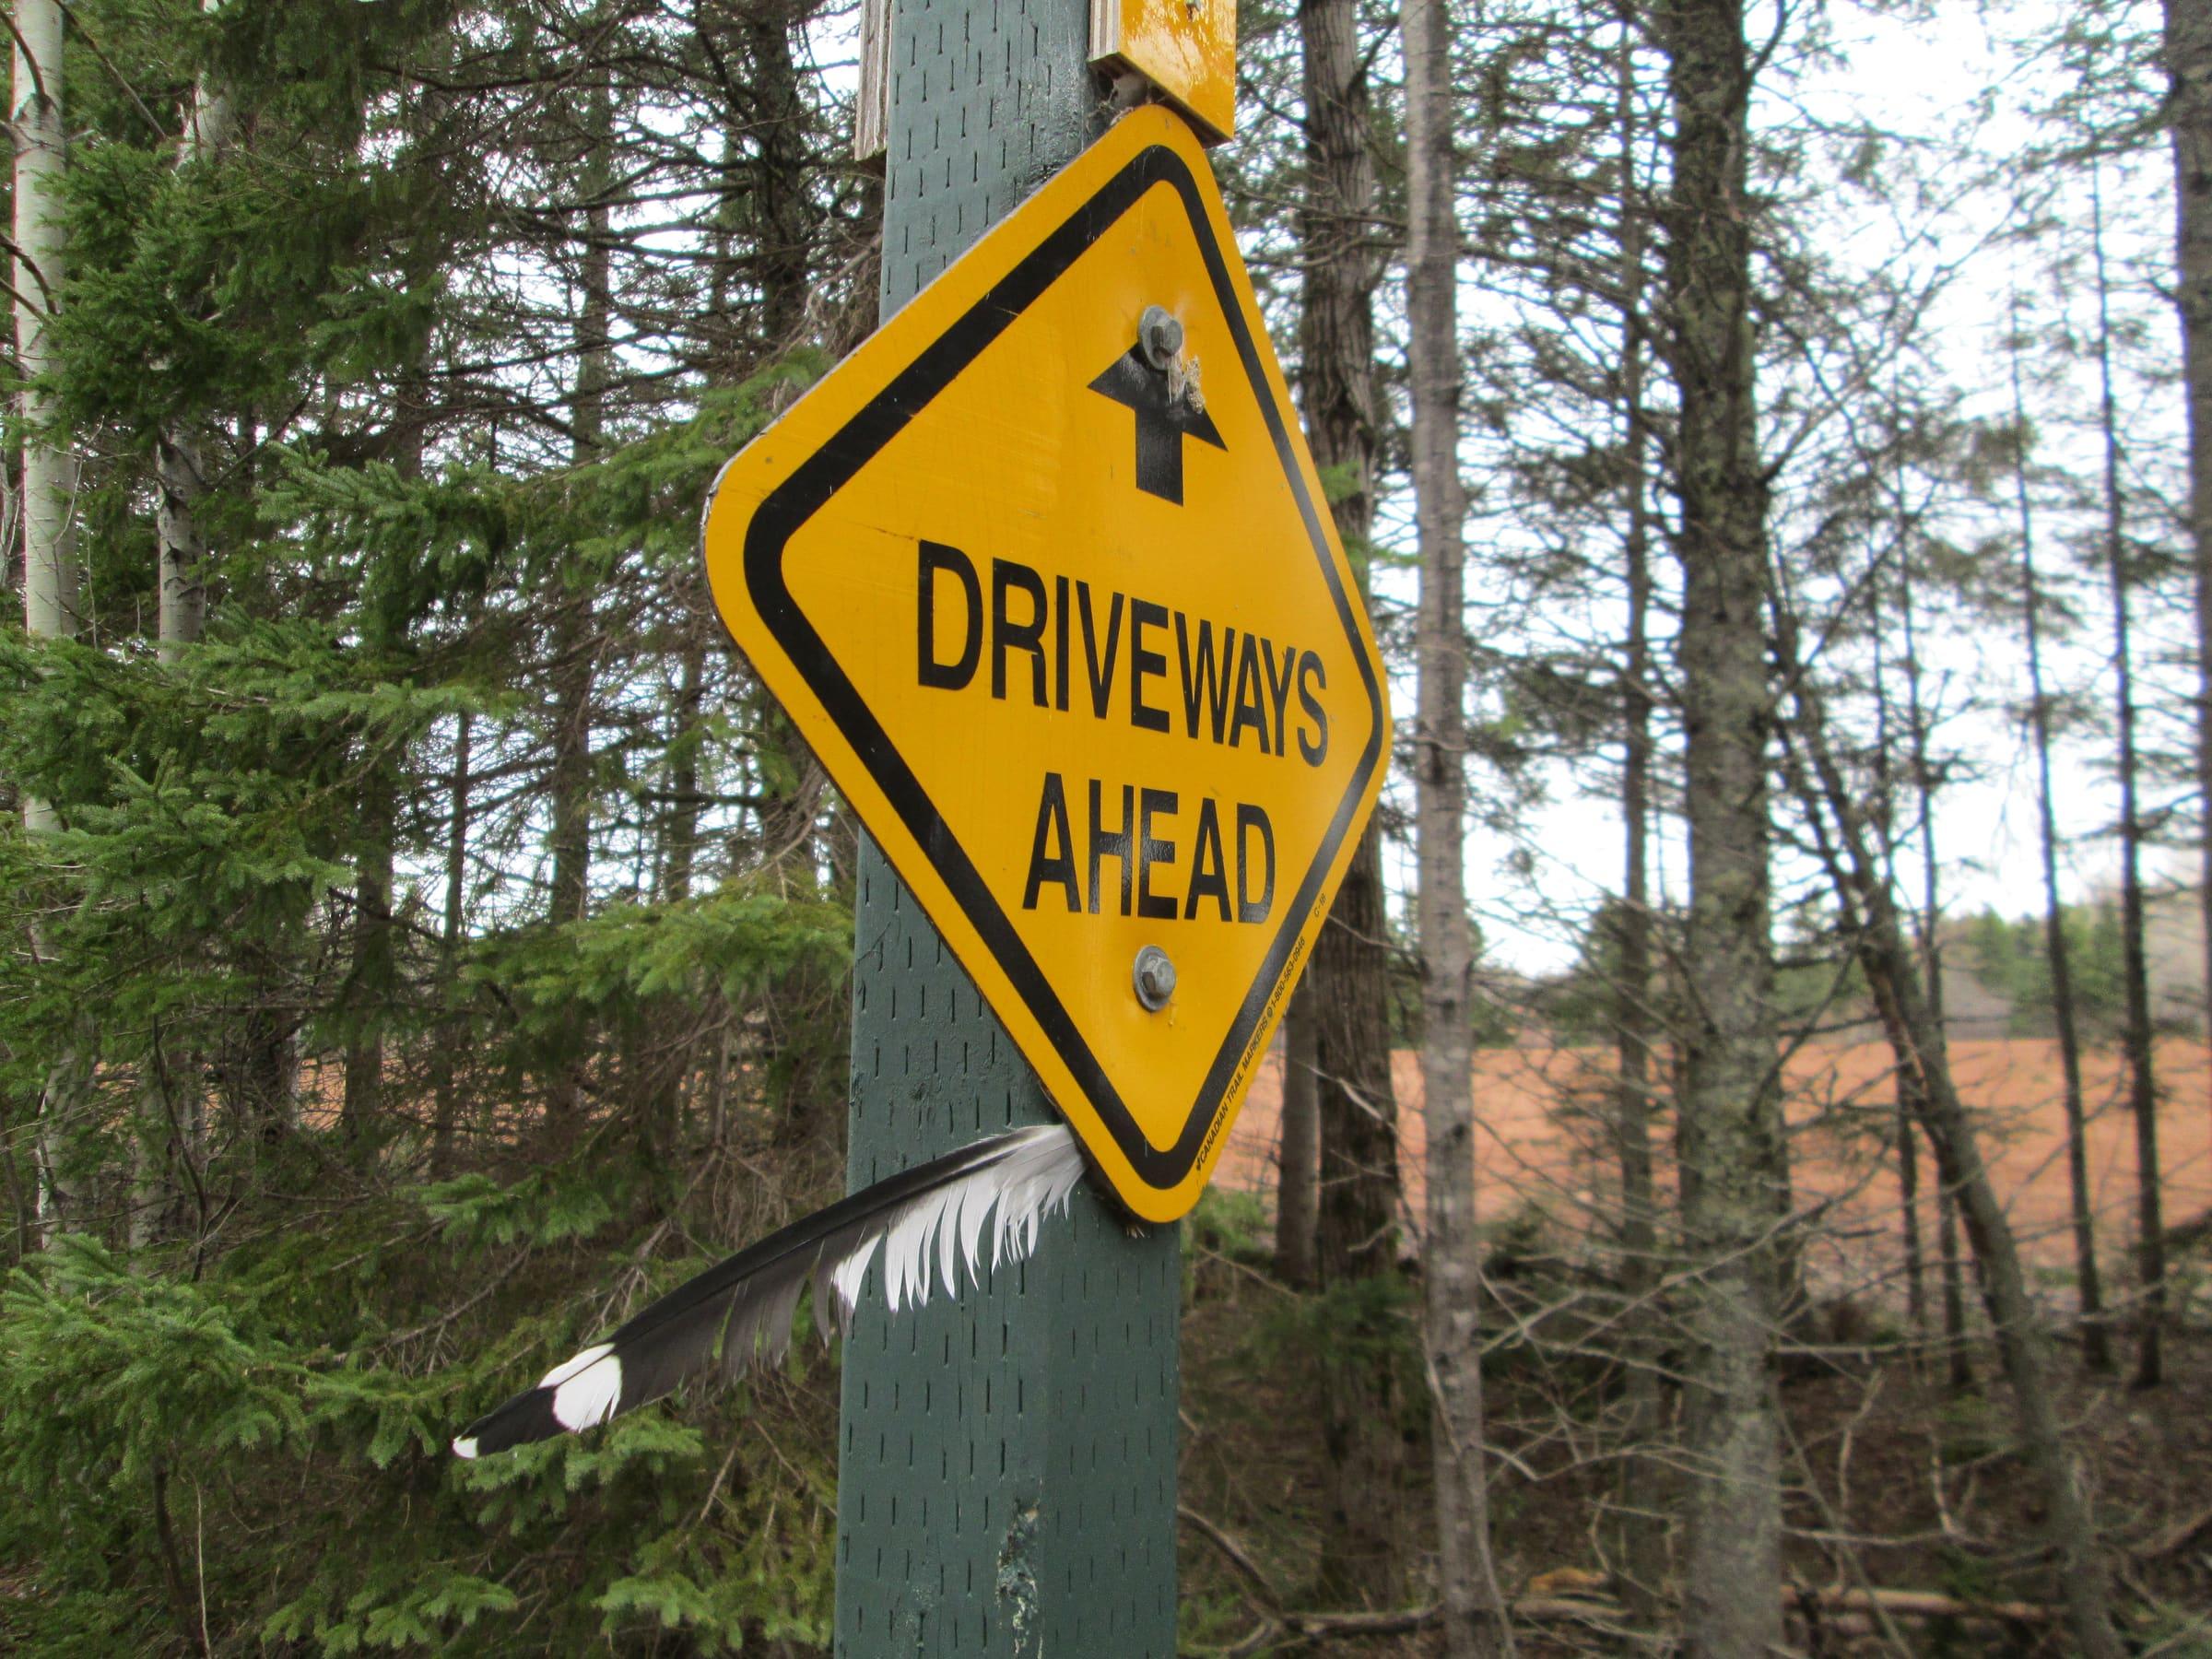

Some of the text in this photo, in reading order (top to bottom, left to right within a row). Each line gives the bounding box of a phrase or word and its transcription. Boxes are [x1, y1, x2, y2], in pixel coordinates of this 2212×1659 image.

[917, 539, 1328, 768] DRIVEWAYS
[1022, 771, 1276, 924] AHEAD
[1199, 1104, 1229, 1164] CANADIAN
[1226, 1073, 1244, 1104] TRAIL
[1241, 1017, 1269, 1071] MARKERS
